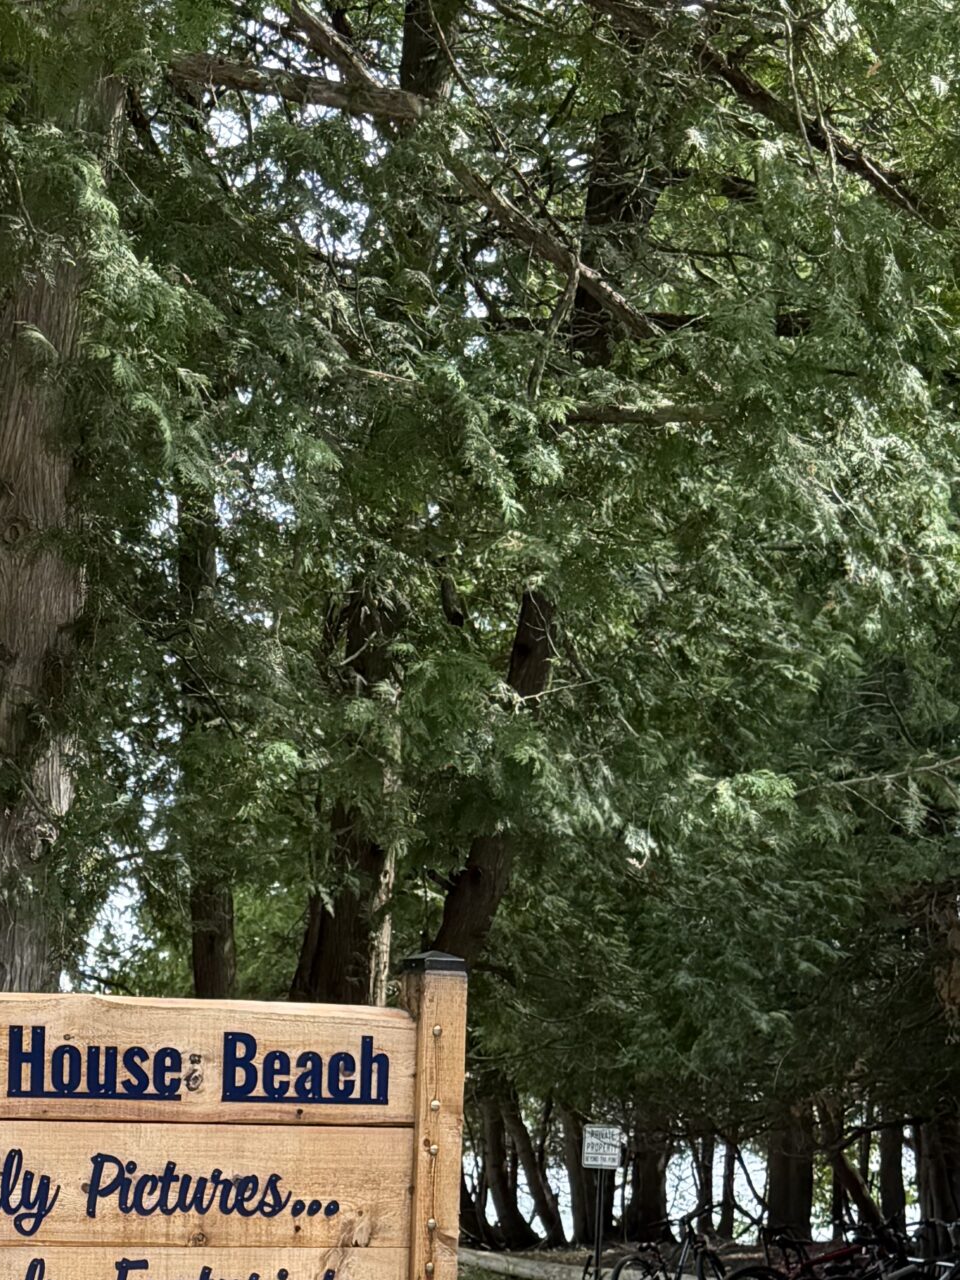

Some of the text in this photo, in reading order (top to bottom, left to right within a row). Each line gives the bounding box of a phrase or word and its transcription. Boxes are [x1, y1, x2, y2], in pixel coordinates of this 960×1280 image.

[8, 1024, 182, 1101] House
[221, 1031, 390, 1105] Beach
[86, 1152, 341, 1219] Pictures...
